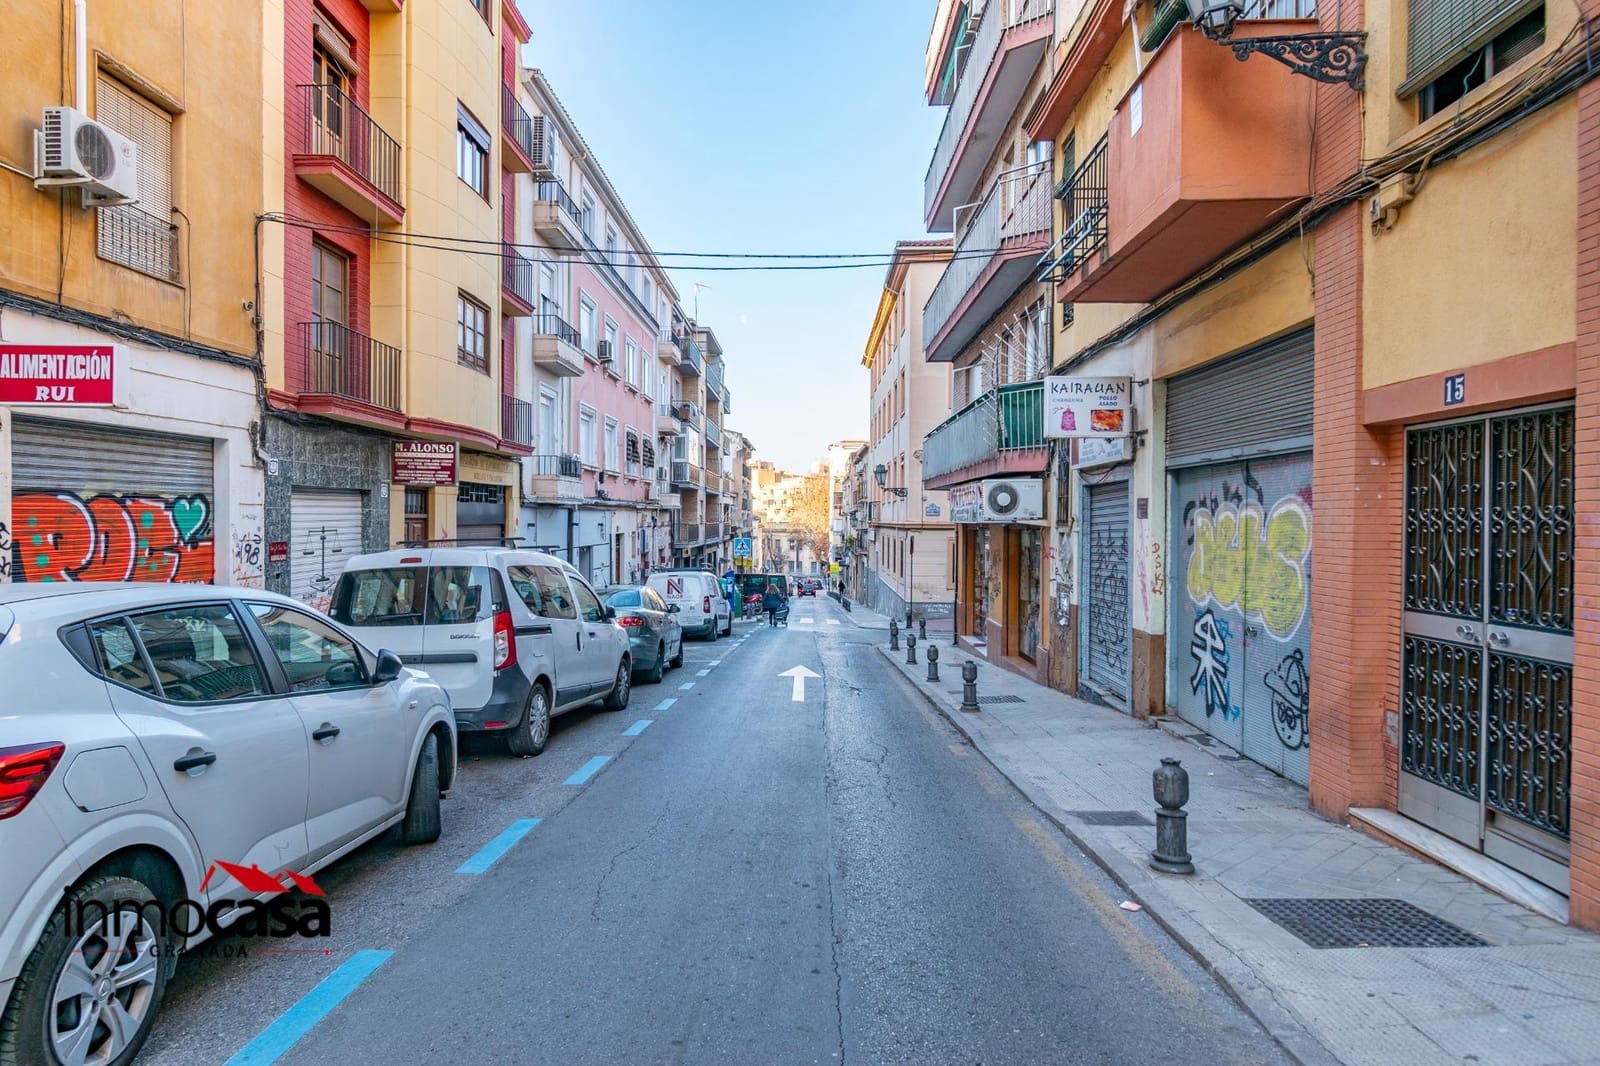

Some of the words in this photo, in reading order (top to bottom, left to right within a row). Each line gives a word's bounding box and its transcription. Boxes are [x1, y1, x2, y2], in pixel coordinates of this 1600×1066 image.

[0, 349, 111, 380] ALIMENTACIÓN
[34, 385, 75, 402] RUI
[1051, 382, 1125, 394] KAIRAUAN
[1446, 376, 1464, 402] 15
[409, 443, 454, 453] ALONSO
